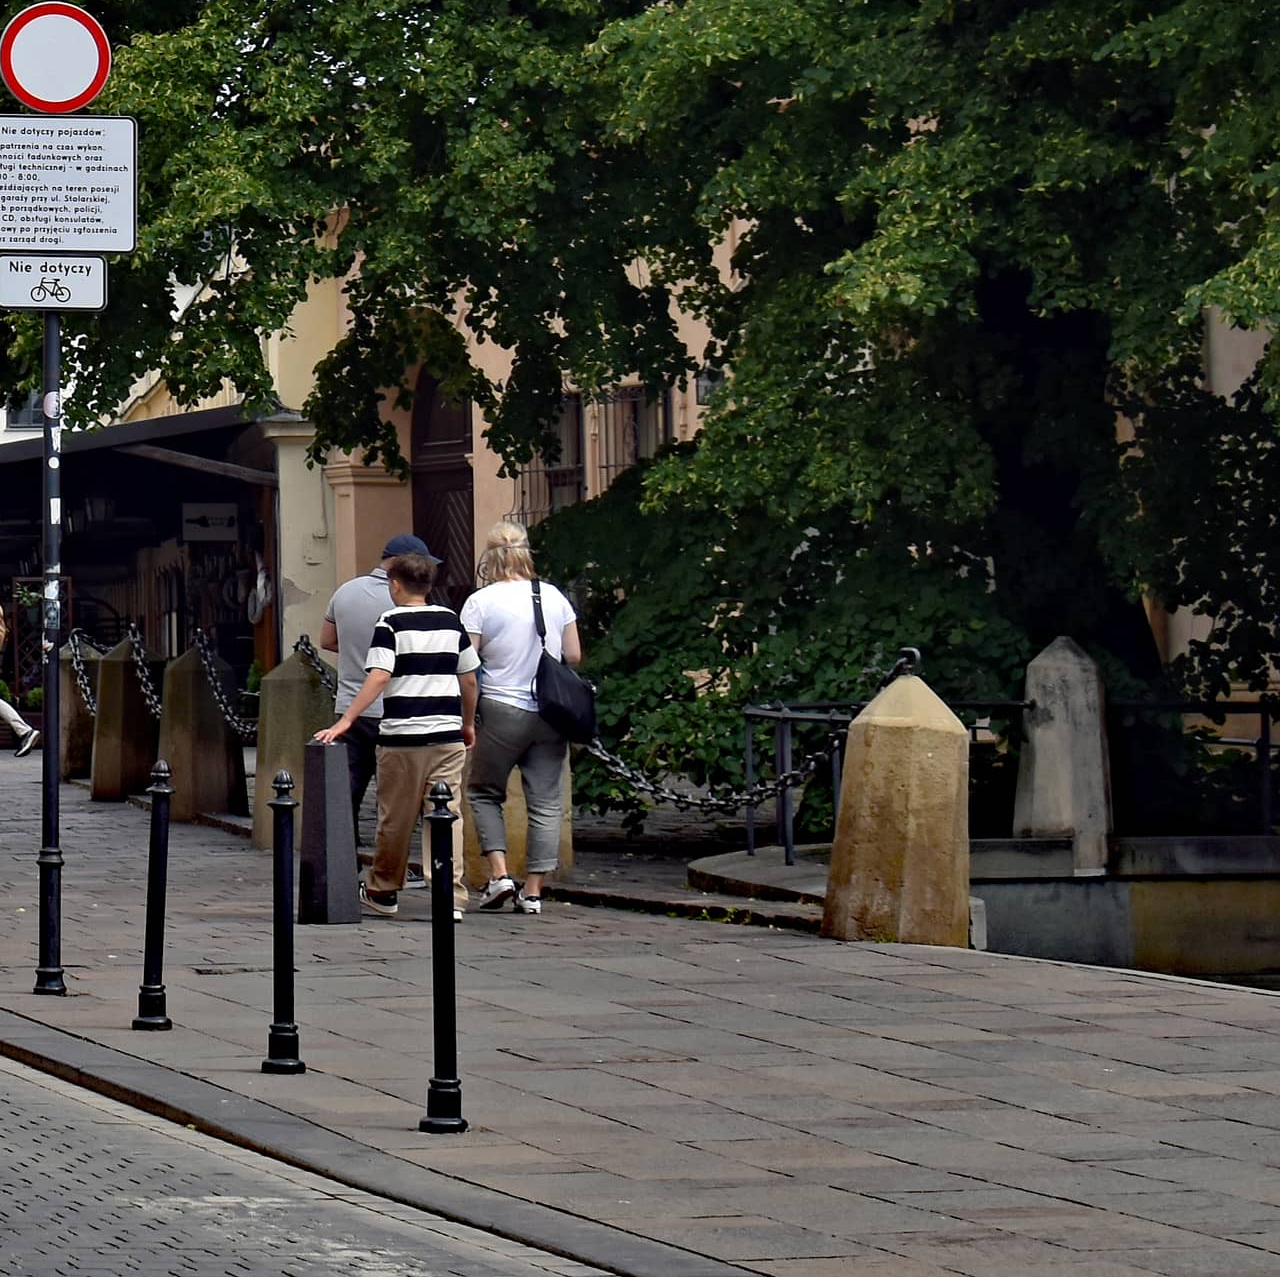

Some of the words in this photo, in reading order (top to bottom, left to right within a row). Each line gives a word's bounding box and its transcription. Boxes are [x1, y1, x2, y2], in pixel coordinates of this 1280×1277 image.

[2, 126, 17, 135] Nie
[20, 127, 54, 138] dotyczy
[27, 153, 82, 163] ładunkowych
[19, 163, 66, 173] technicznej
[85, 164, 129, 174] godzinach
[90, 185, 120, 195] posesji
[0, 194, 28, 204] garaży
[31, 195, 48, 204] przy
[51, 194, 61, 202] ul.
[20, 215, 51, 224] obsługi
[20, 226, 31, 234] po
[34, 225, 70, 235] przyjęciu
[73, 225, 118, 235] zgłoszenia
[9, 235, 36, 244] zarząd
[39, 235, 65, 245] drogi.
[9, 260, 33, 273] Nie
[40, 261, 92, 277] dotyczy
